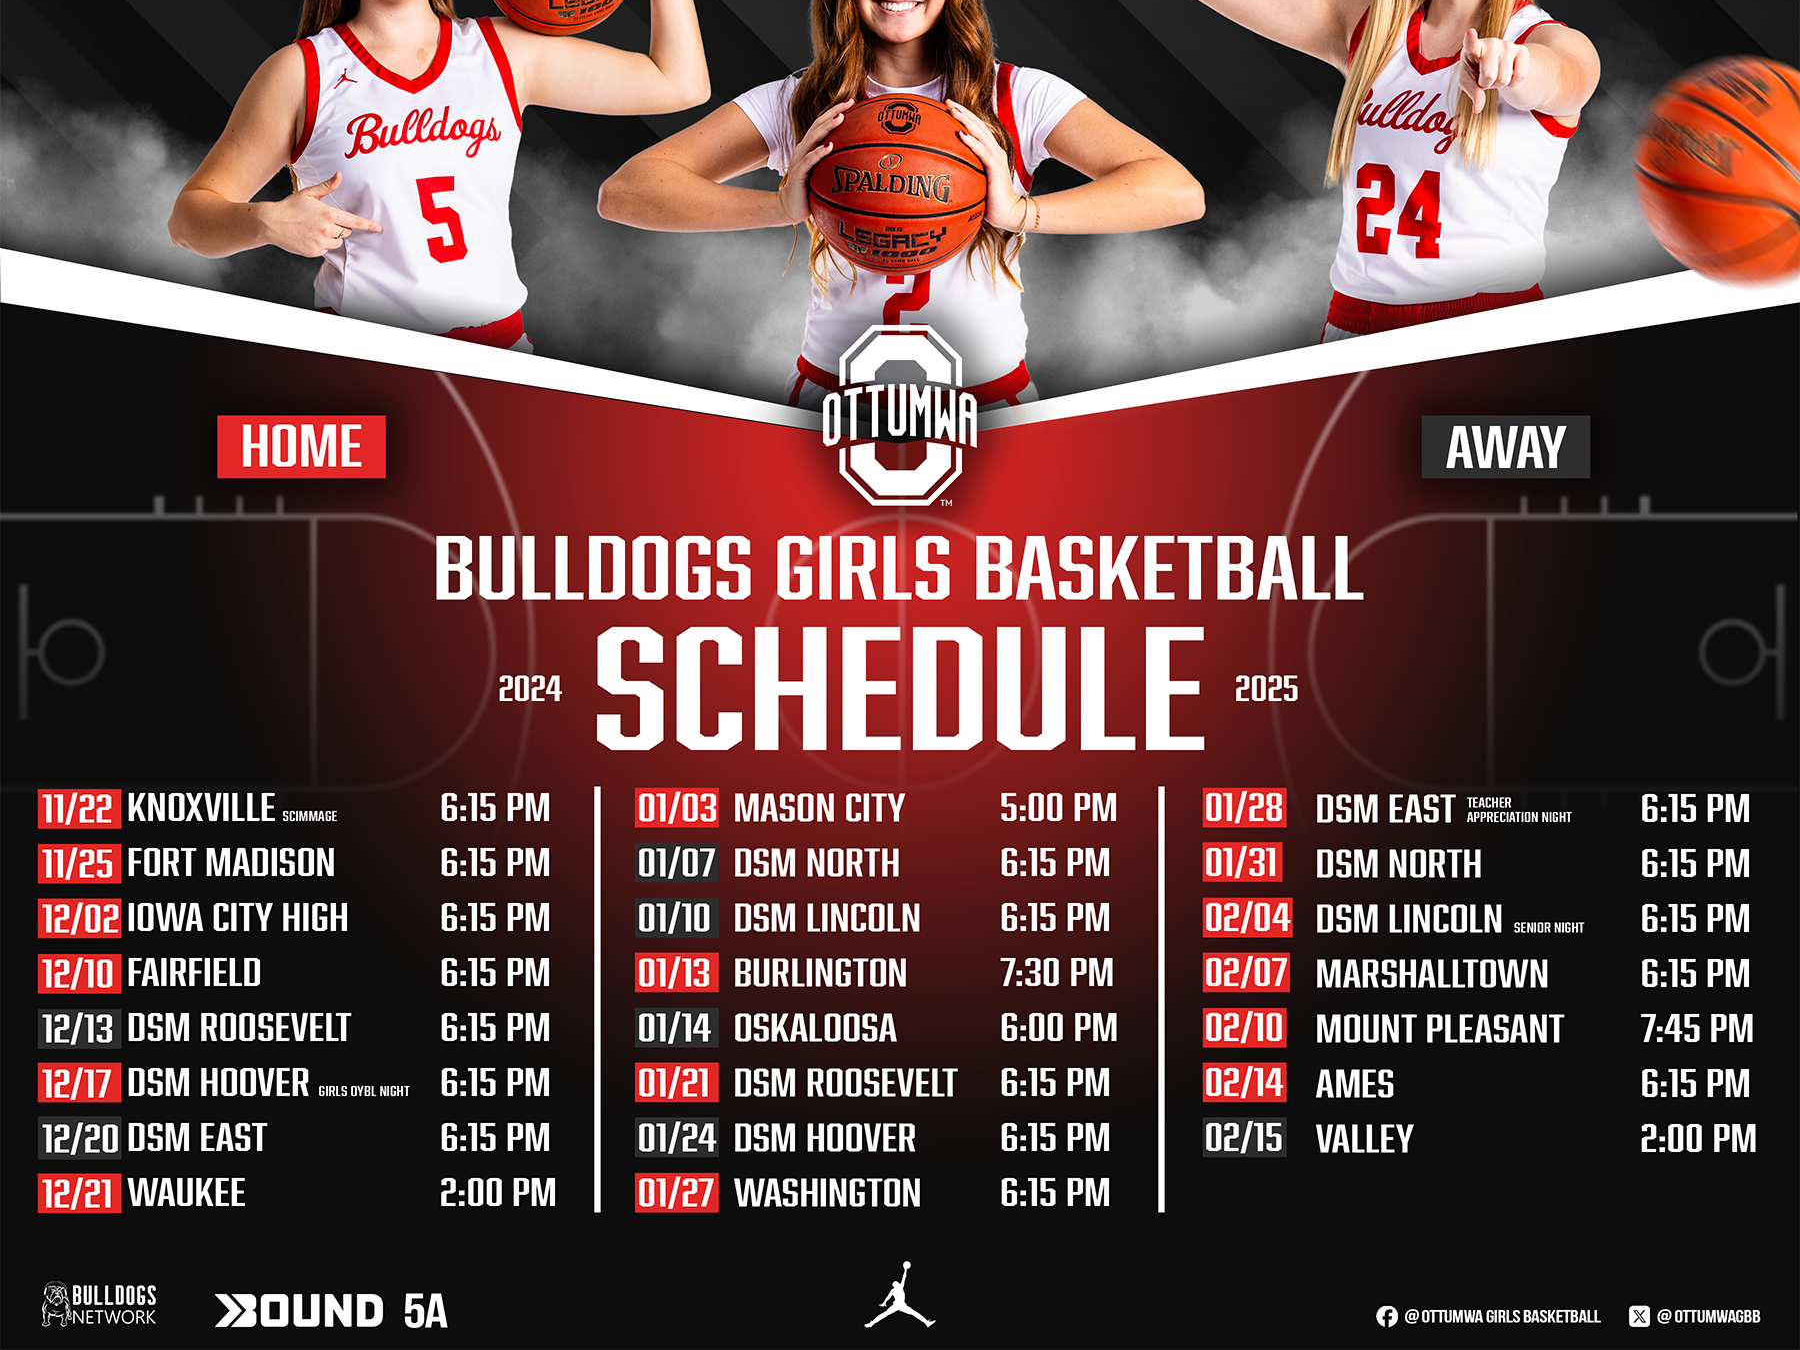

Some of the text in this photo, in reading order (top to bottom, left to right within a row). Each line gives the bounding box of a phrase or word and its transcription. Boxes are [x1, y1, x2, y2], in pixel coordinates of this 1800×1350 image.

[344, 105, 502, 160] Bulldogs
[877, 109, 922, 126] OTTUMWA
[831, 165, 951, 204] SPALDING
[415, 175, 468, 264] 5
[1356, 162, 1442, 259] 24
[839, 221, 947, 249] LEGACY
[869, 245, 937, 258] 1000
[822, 383, 978, 449] OTTUMWA
[243, 424, 362, 467] HOME
[1446, 426, 1567, 468] AWAY
[436, 536, 1364, 600] BULLDOGS GIRLS BASKETBALL
[500, 675, 562, 701] 2024
[597, 627, 1204, 750] SCHEDULE
[1236, 675, 1298, 701] 2025
[42, 792, 275, 825] 11/22 KNOXVILLE
[283, 811, 337, 821] SCIMMAGE
[442, 793, 549, 821] 6:15 PM
[639, 791, 905, 824] 01/03 MASON CITY
[1001, 793, 1116, 821] 5:00 PM
[1206, 791, 1456, 823] 01/28 DSM EAST
[1467, 797, 1511, 808] TEACHER
[1467, 812, 1572, 822] APPRECIATION NIGHT
[1642, 794, 1749, 822] 6:15 PM
[42, 847, 334, 880] 11/25 FORT MADISON
[639, 846, 899, 879] 01/07 DSM NORTH
[1002, 848, 1109, 876] 6:15 PM
[1206, 846, 1481, 878] 01/31 DSM NORTH
[42, 902, 347, 935] 12/02 IOWA CITY HIGH
[639, 901, 919, 934] 01/10 DSM LINCOLN
[1206, 901, 1501, 933] 02/04 DSM LINCOLN
[1514, 922, 1584, 933] SENIOR NIGHT
[1642, 904, 1749, 932] 6:15 PM
[42, 957, 260, 990] 12/10 FAIRFIELD
[442, 958, 549, 986] 6:15 PM
[639, 956, 906, 989] 01/13 BURLINGTON
[1000, 958, 1113, 986] 7:30 PM
[1206, 956, 1547, 988] 02/07 MARSHALLTOWN
[42, 1012, 351, 1045] 12/13 DSM ROOSEVELT
[639, 1011, 897, 1044] 01/14 OSKALOOSA
[1002, 1013, 1117, 1041] 6:00 PM
[1206, 1011, 1564, 1043] 02/10 MOUNT PLEASANT
[1641, 1014, 1753, 1042] 7:45 PM
[42, 1067, 309, 1100] 12/17 DSM HOOVER
[319, 1086, 410, 1096] GIRLS OYBL NIGHT
[442, 1068, 549, 1096] 6:15 PM
[639, 1066, 958, 1099] 01/21 DSM ROOSEVELT
[1206, 1066, 1393, 1098] 02/14 AMES
[42, 1122, 267, 1155] 12/20 DSM EAST
[639, 1121, 915, 1154] 01/24 DSM HOOVER
[1206, 1121, 1414, 1153] 02/15 VALLEY
[1642, 1124, 1756, 1152] 2:00 PM
[42, 1177, 245, 1210] 12/21 WAUKEE
[441, 1178, 555, 1206] 2:00 PM
[639, 1176, 920, 1209] 01/27 WASHINGTON
[1002, 1178, 1109, 1206] 6:15 PM
[73, 1285, 156, 1305] BULLDOGS
[215, 1294, 383, 1327] BOUND
[405, 1293, 448, 1328] 5A
[73, 1310, 155, 1324] NETWORK
[1422, 1310, 1483, 1323] OTTUMWA
[1486, 1310, 1520, 1323] GIRLS
[1524, 1310, 1601, 1323] BASKETBALL
[1675, 1310, 1760, 1323] OTTUMWAGBB
